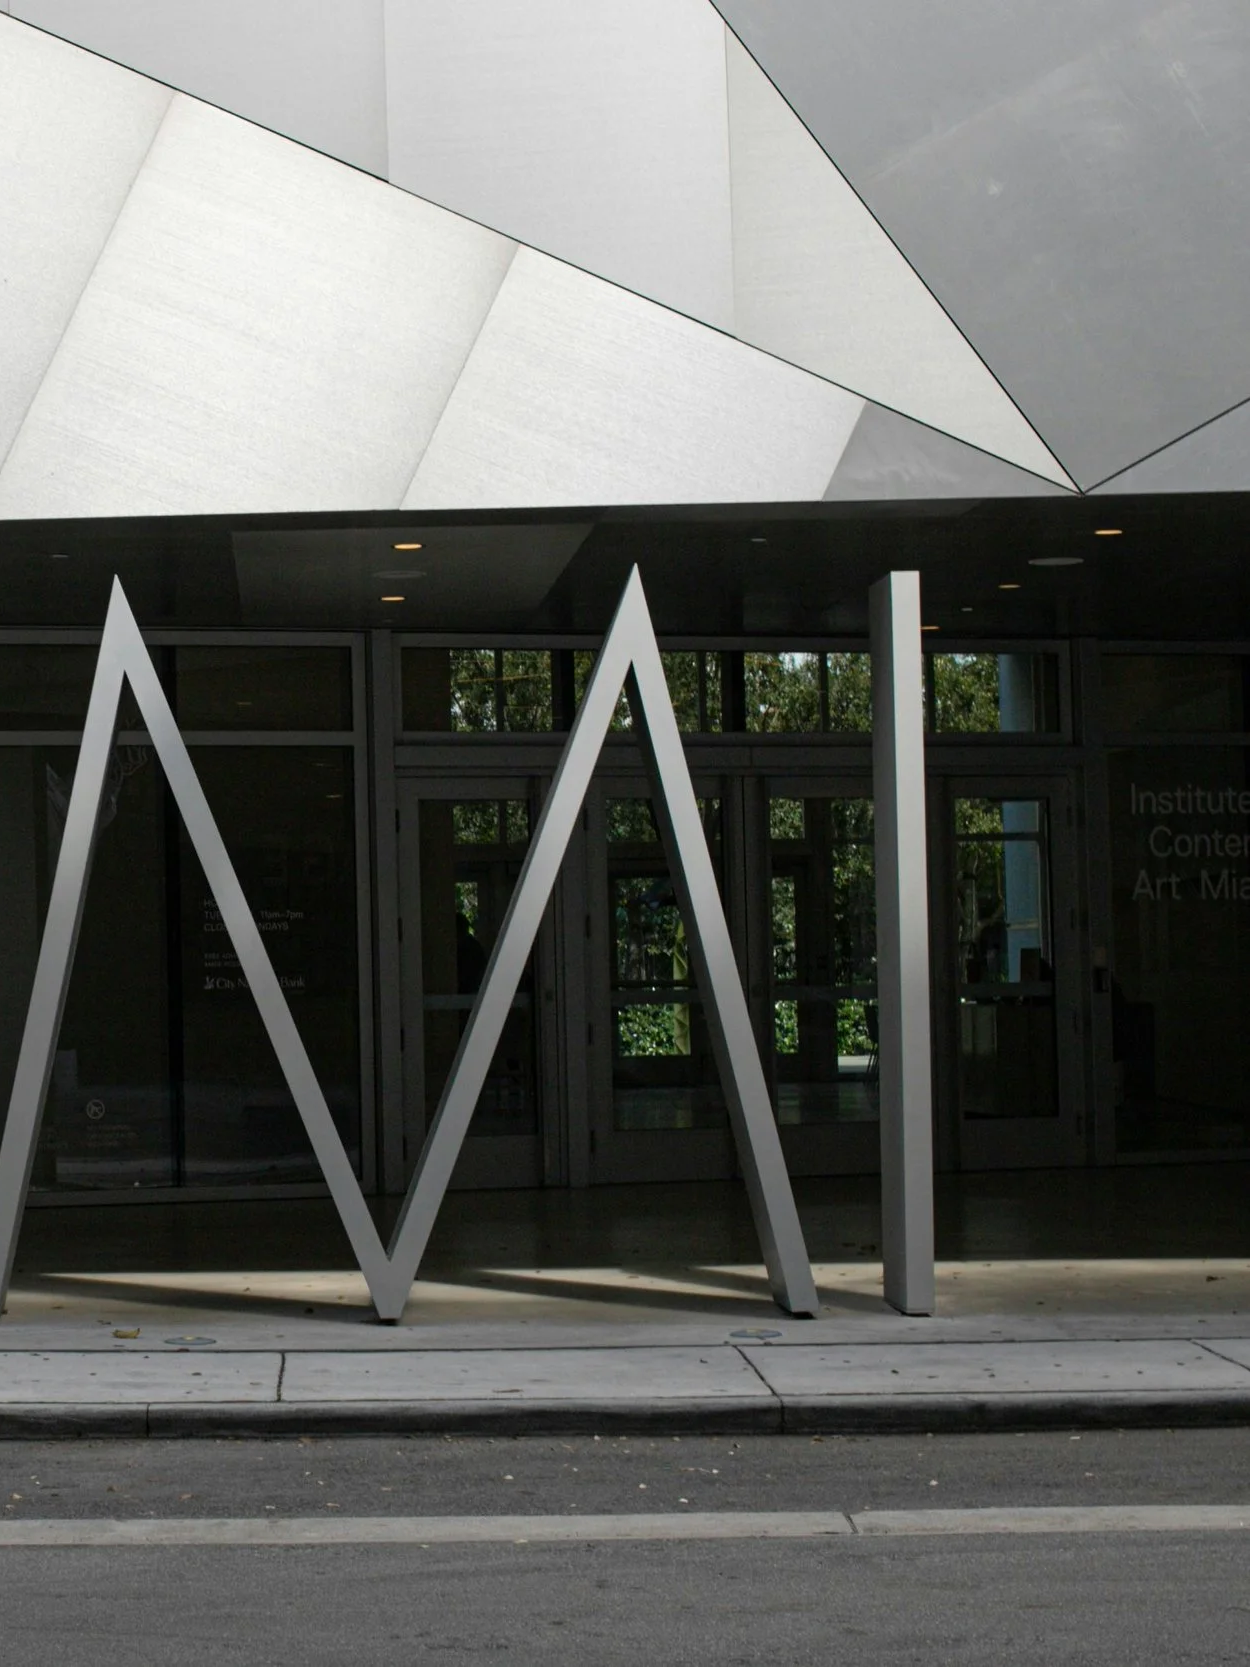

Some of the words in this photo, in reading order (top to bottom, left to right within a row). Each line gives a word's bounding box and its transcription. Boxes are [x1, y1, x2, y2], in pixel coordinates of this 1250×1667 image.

[1131, 782, 1250, 815] Institute
[1131, 868, 1183, 901] Art
[1201, 868, 1250, 901] Mia
